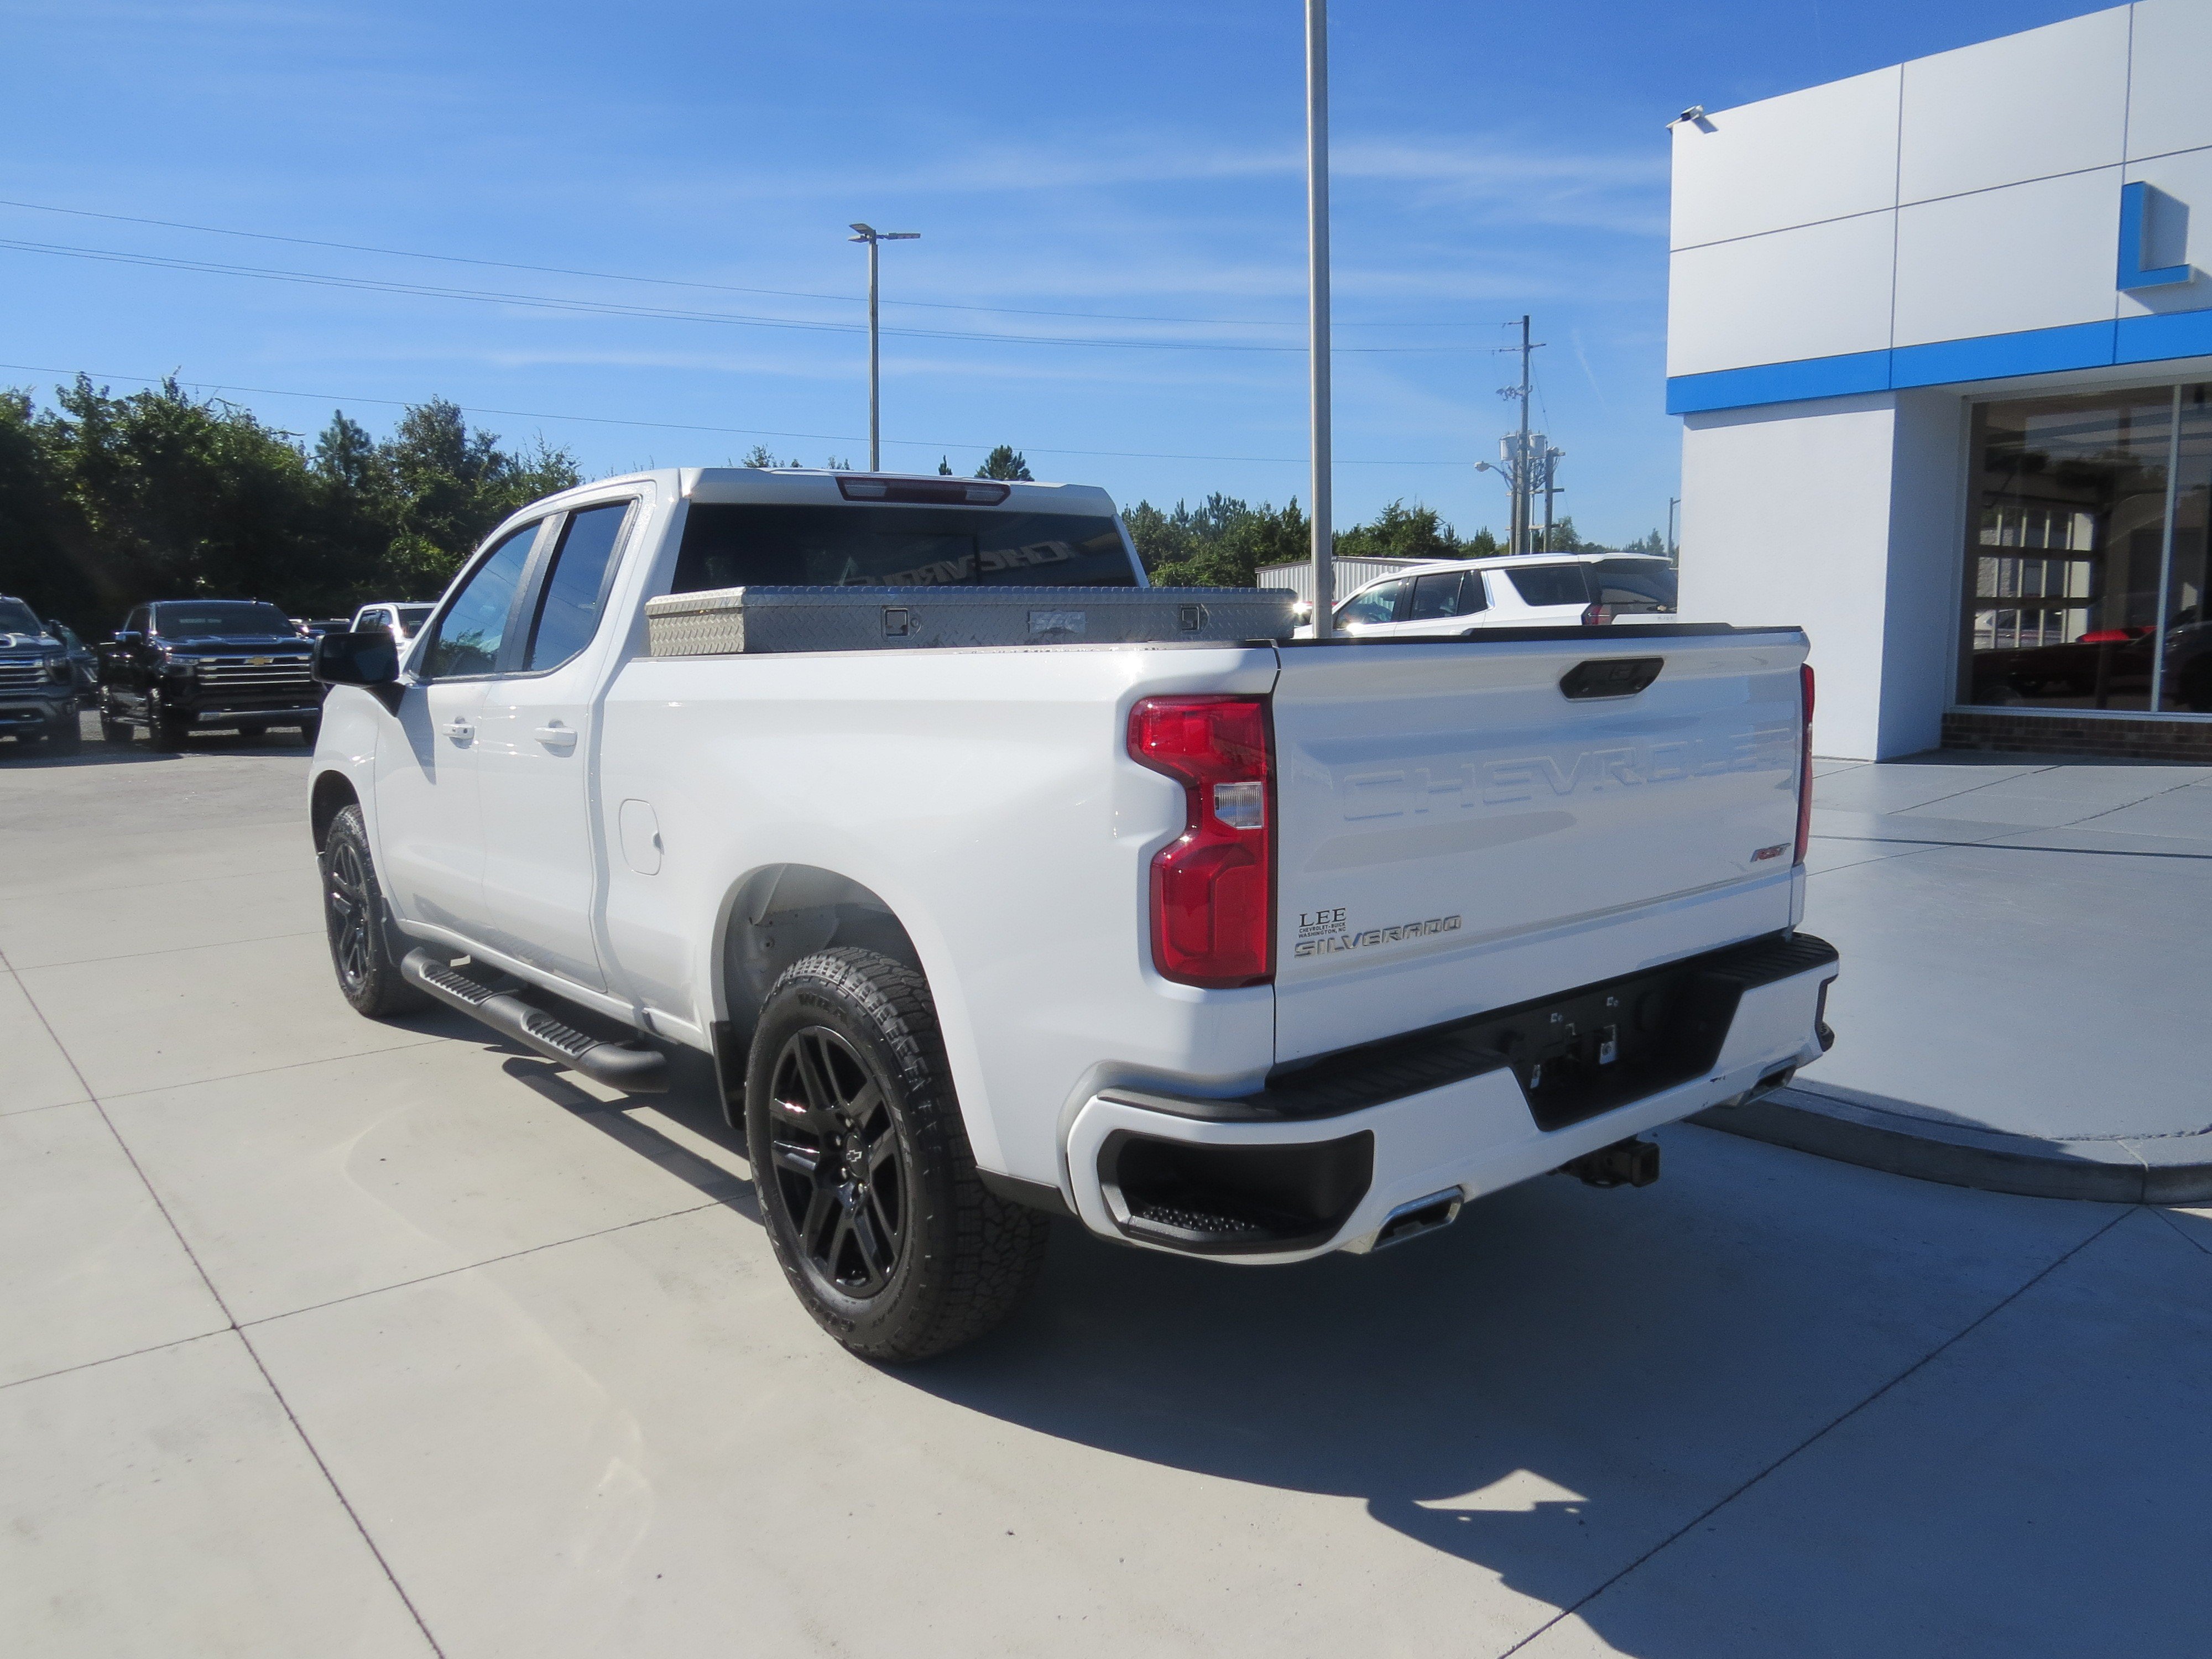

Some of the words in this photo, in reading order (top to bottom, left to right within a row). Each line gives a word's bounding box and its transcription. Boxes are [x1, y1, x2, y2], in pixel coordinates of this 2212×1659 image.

[1750, 843, 1791, 862] RST
[1299, 907, 1346, 927] LEE
[1294, 915, 1462, 958] SILVERADO
[1298, 928, 1338, 938] WASHINGTON,
